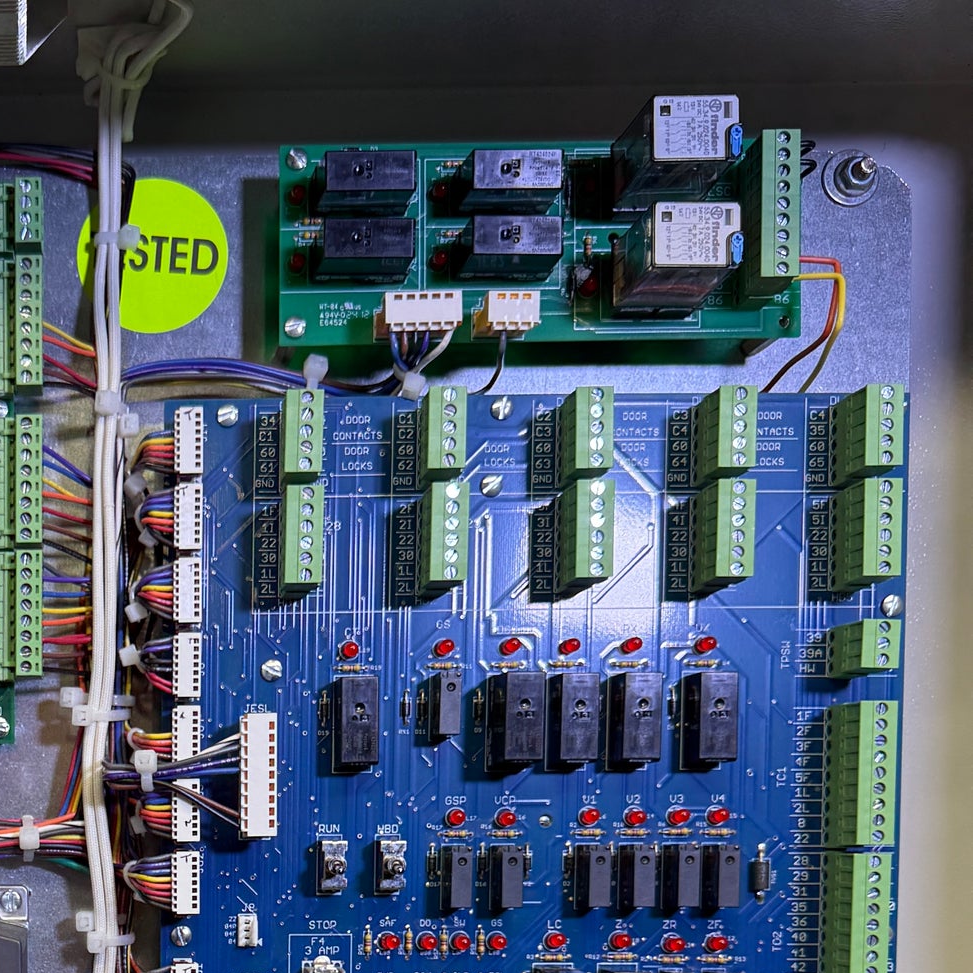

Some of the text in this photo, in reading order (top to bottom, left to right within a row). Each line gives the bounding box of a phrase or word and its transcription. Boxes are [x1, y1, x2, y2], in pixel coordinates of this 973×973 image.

[91, 231, 219, 275] STED
[261, 417, 275, 426] 34
[345, 415, 370, 424] DOOR
[398, 415, 414, 424] C1
[398, 429, 413, 439] C2
[536, 427, 551, 437] C3
[809, 426, 825, 435] 35
[333, 431, 382, 440] CONTACTS
[344, 447, 369, 456] DOOR
[341, 462, 373, 471] LOCKS
[398, 461, 412, 470] 62
[484, 458, 516, 467] LOCKS
[535, 460, 551, 468] 63
[809, 458, 825, 467] 65
[255, 479, 275, 488] GND
[393, 477, 412, 486] GND
[812, 500, 827, 510] 5F
[398, 535, 414, 544] 22
[799, 649, 822, 658] 39A
[800, 664, 815, 673] HW
[244, 704, 268, 713] JESL
[796, 741, 811, 751] 3F
[795, 757, 810, 766] 4F
[777, 767, 786, 787] TC1
[445, 796, 467, 805] GSP
[495, 796, 516, 804] VCP
[318, 824, 340, 833] RUN
[309, 920, 337, 929] STOP
[379, 919, 396, 927] SAF
[547, 920, 562, 929] LC
[311, 937, 324, 945] F4
[305, 946, 340, 955] 3 AMP
